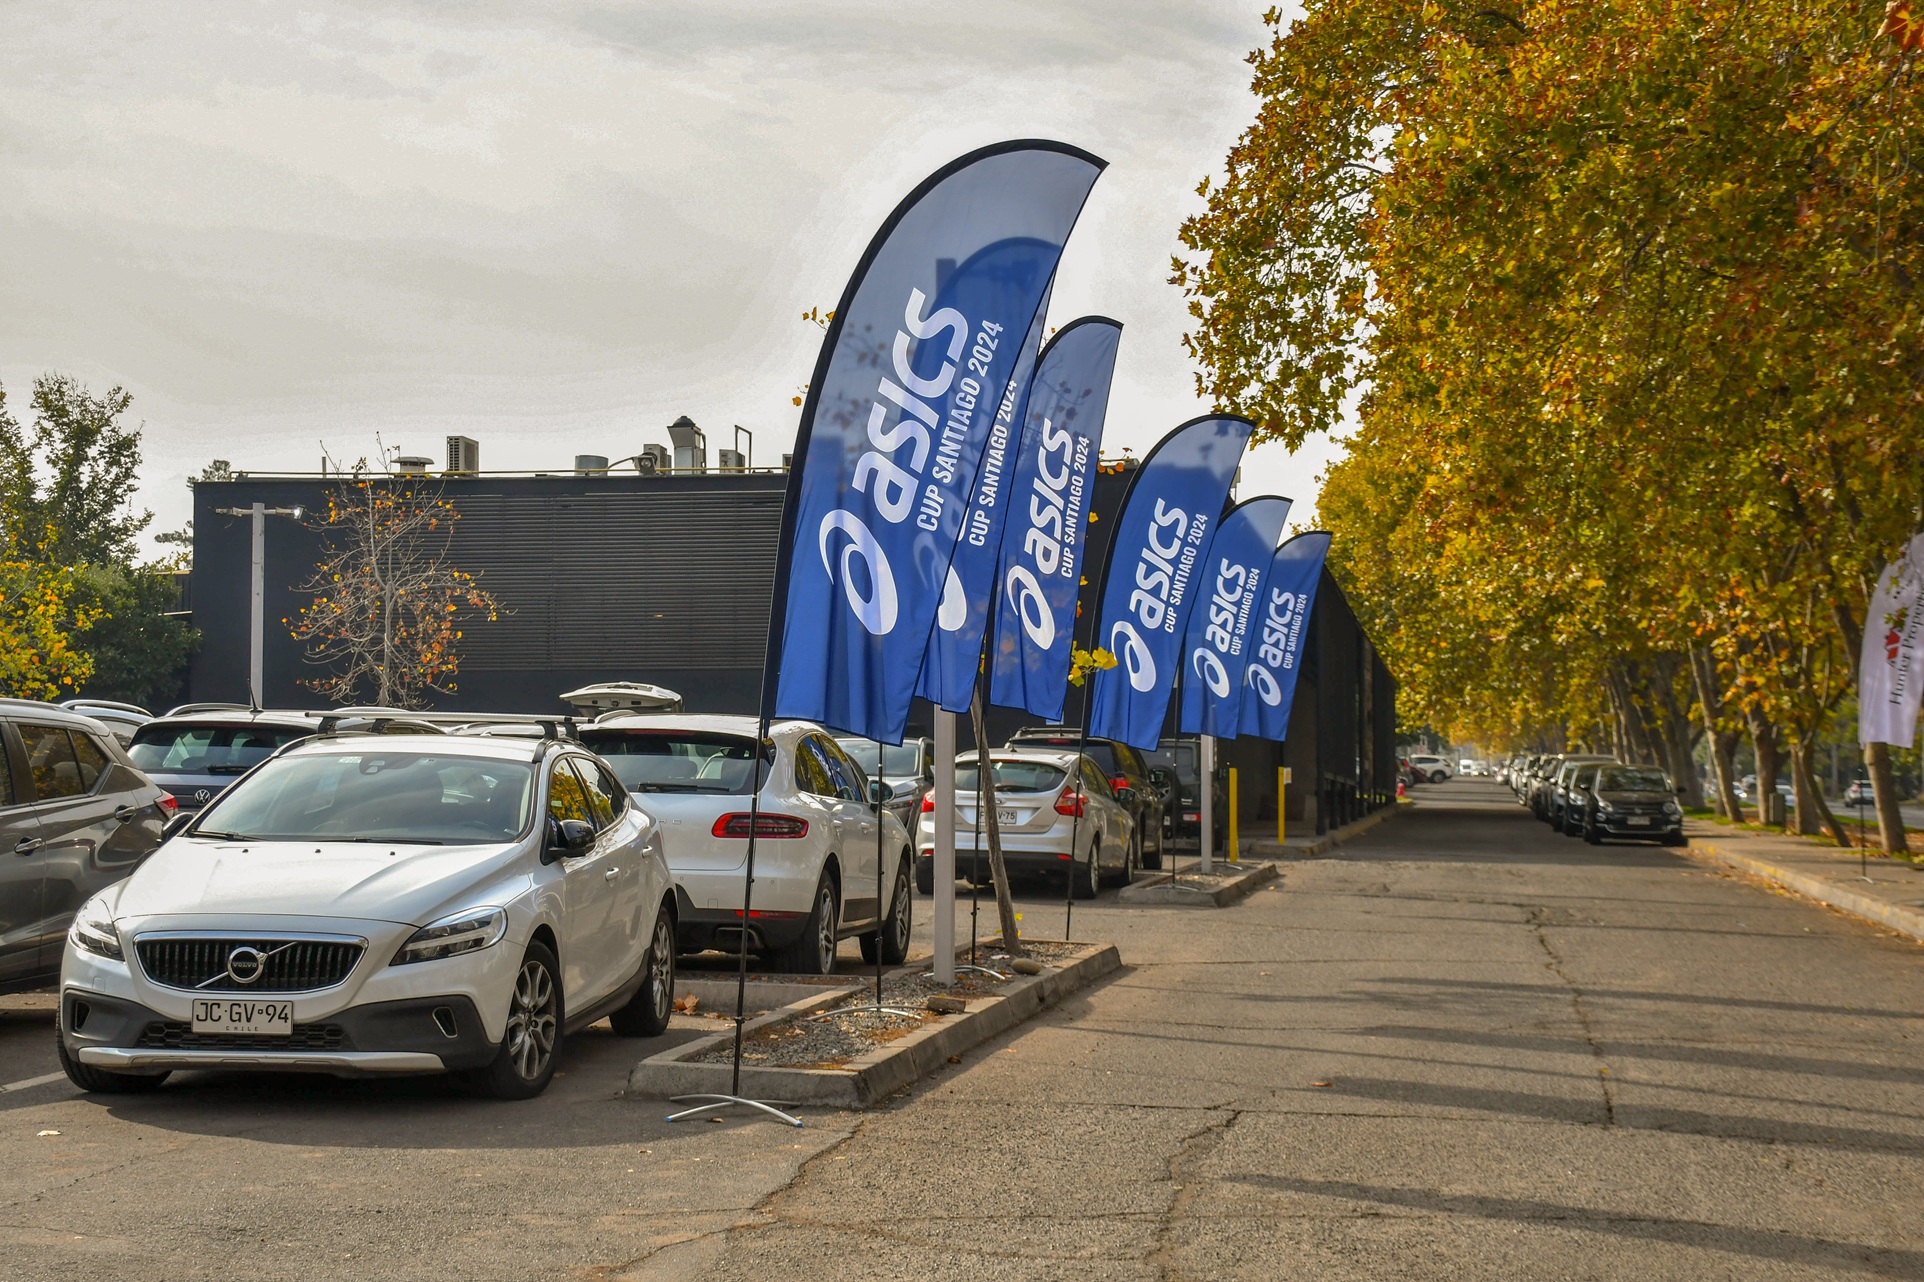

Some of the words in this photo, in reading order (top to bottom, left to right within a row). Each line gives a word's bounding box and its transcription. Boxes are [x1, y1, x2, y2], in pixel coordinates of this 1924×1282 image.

[916, 484, 945, 532] CUP
[931, 377, 981, 485] SANTIAGO
[967, 319, 1004, 378] 2024
[979, 424, 1008, 508] SANTIAGO
[1073, 436, 1090, 474] 2024
[968, 509, 991, 547] CUP
[1063, 474, 1084, 546] SANTIAGO
[1187, 513, 1208, 546] 2024
[1061, 547, 1075, 579] CUP
[1170, 546, 1197, 606] SANTIAGO
[1246, 567, 1260, 591] 2024
[1164, 606, 1178, 634] CUP
[1234, 591, 1254, 635] SANTIAGO
[1294, 594, 1308, 614] 2024
[1230, 636, 1243, 656] CUP
[1286, 614, 1303, 652] SANTIAGO
[1282, 652, 1294, 669] CUP
[1889, 652, 1912, 705] Hunter
